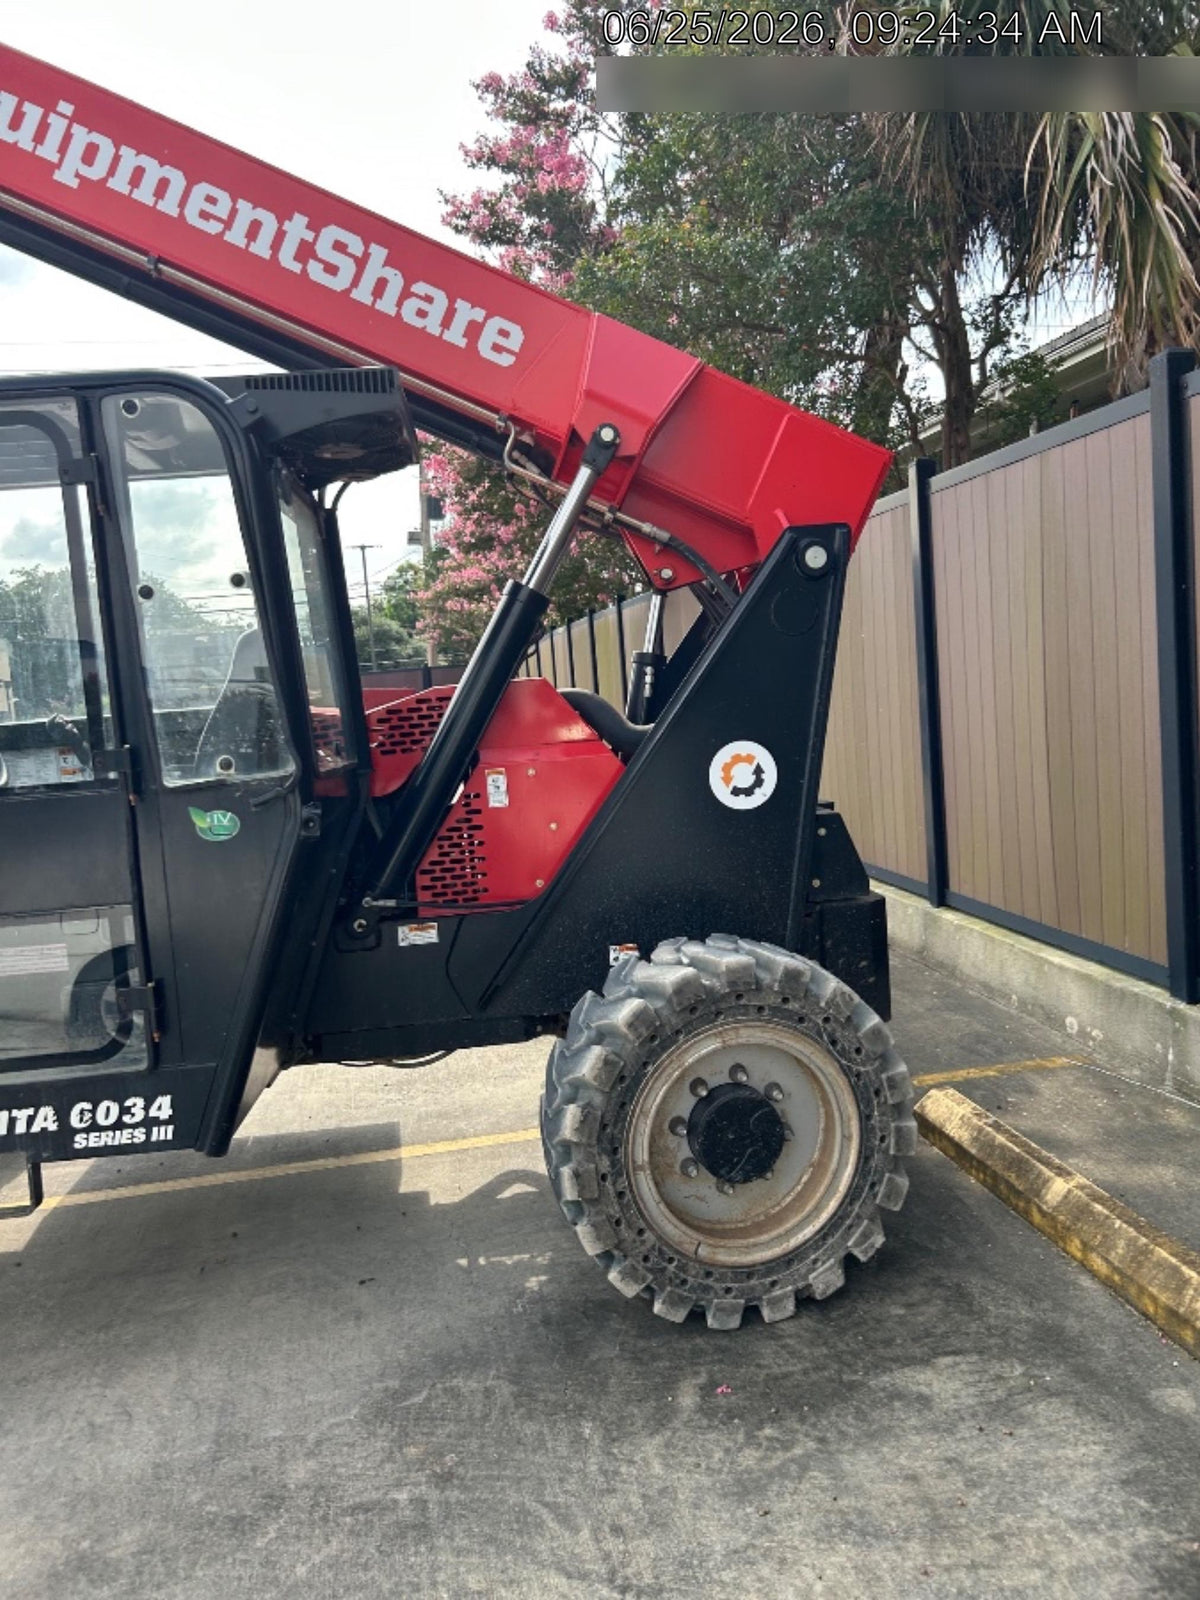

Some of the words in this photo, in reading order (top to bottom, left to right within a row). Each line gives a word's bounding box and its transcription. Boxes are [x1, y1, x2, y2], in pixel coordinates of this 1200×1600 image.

[70, 1095, 173, 1129] 6034
[73, 1127, 147, 1149] SERIES
[150, 1125, 174, 1142] III
